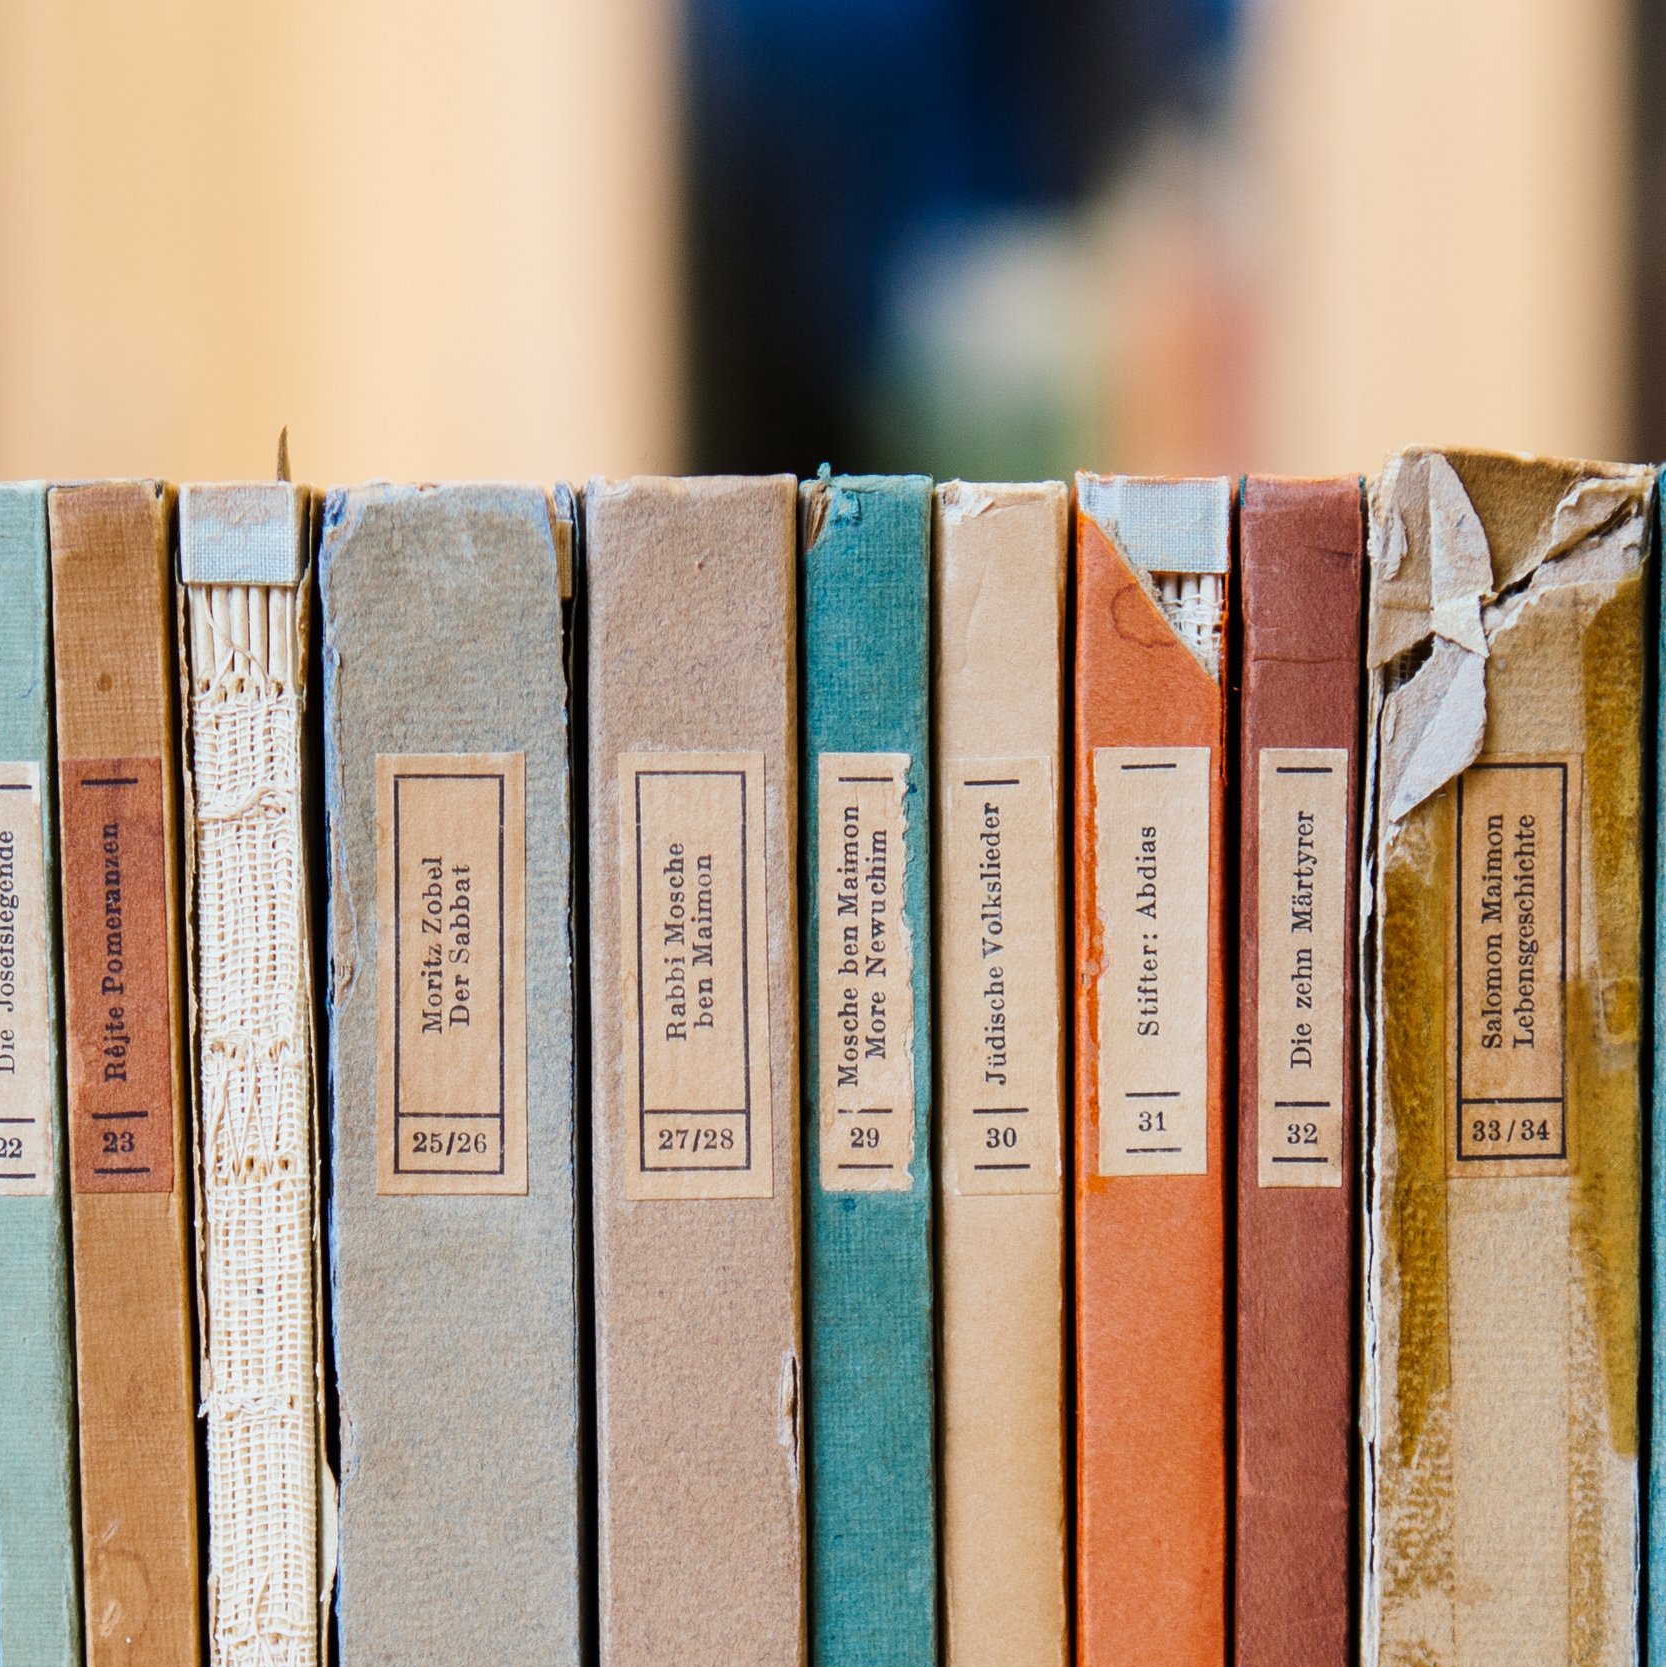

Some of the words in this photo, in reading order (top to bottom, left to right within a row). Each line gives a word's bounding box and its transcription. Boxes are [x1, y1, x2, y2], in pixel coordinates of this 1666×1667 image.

[101, 822, 125, 997] Pomeranzen
[421, 855, 443, 934] Zobel
[663, 843, 685, 946] Mosche
[690, 854, 713, 967] Maimon
[864, 829, 887, 978] Newuchim
[979, 802, 1004, 959] Volkslieder
[1134, 826, 1157, 920] Abdias
[1291, 810, 1318, 934] Märtyrer
[1480, 813, 1504, 925] Maimon
[448, 865, 471, 964] Sabbat
[837, 925, 859, 976] ben
[1512, 814, 1540, 1050] Lebensgeschichte
[420, 943, 443, 1035] Moritz
[448, 974, 470, 1028] Der
[663, 956, 687, 1042] Rabbi
[693, 977, 714, 1029] ben
[1136, 934, 1160, 1036] Stifter:
[1290, 947, 1313, 1009] zehn
[1480, 932, 1504, 1049] Salomon
[837, 988, 859, 1088] Mosche
[864, 991, 887, 1060] More
[983, 966, 1007, 1086] Jüdische
[1290, 1023, 1312, 1069] Die
[102, 1130, 136, 1154] 23
[412, 1131, 487, 1157] 25/26
[658, 1128, 734, 1153] 27/28
[850, 1127, 880, 1149] 29
[985, 1127, 1017, 1149] 30
[1138, 1111, 1166, 1132] 31
[1287, 1122, 1318, 1145] 32
